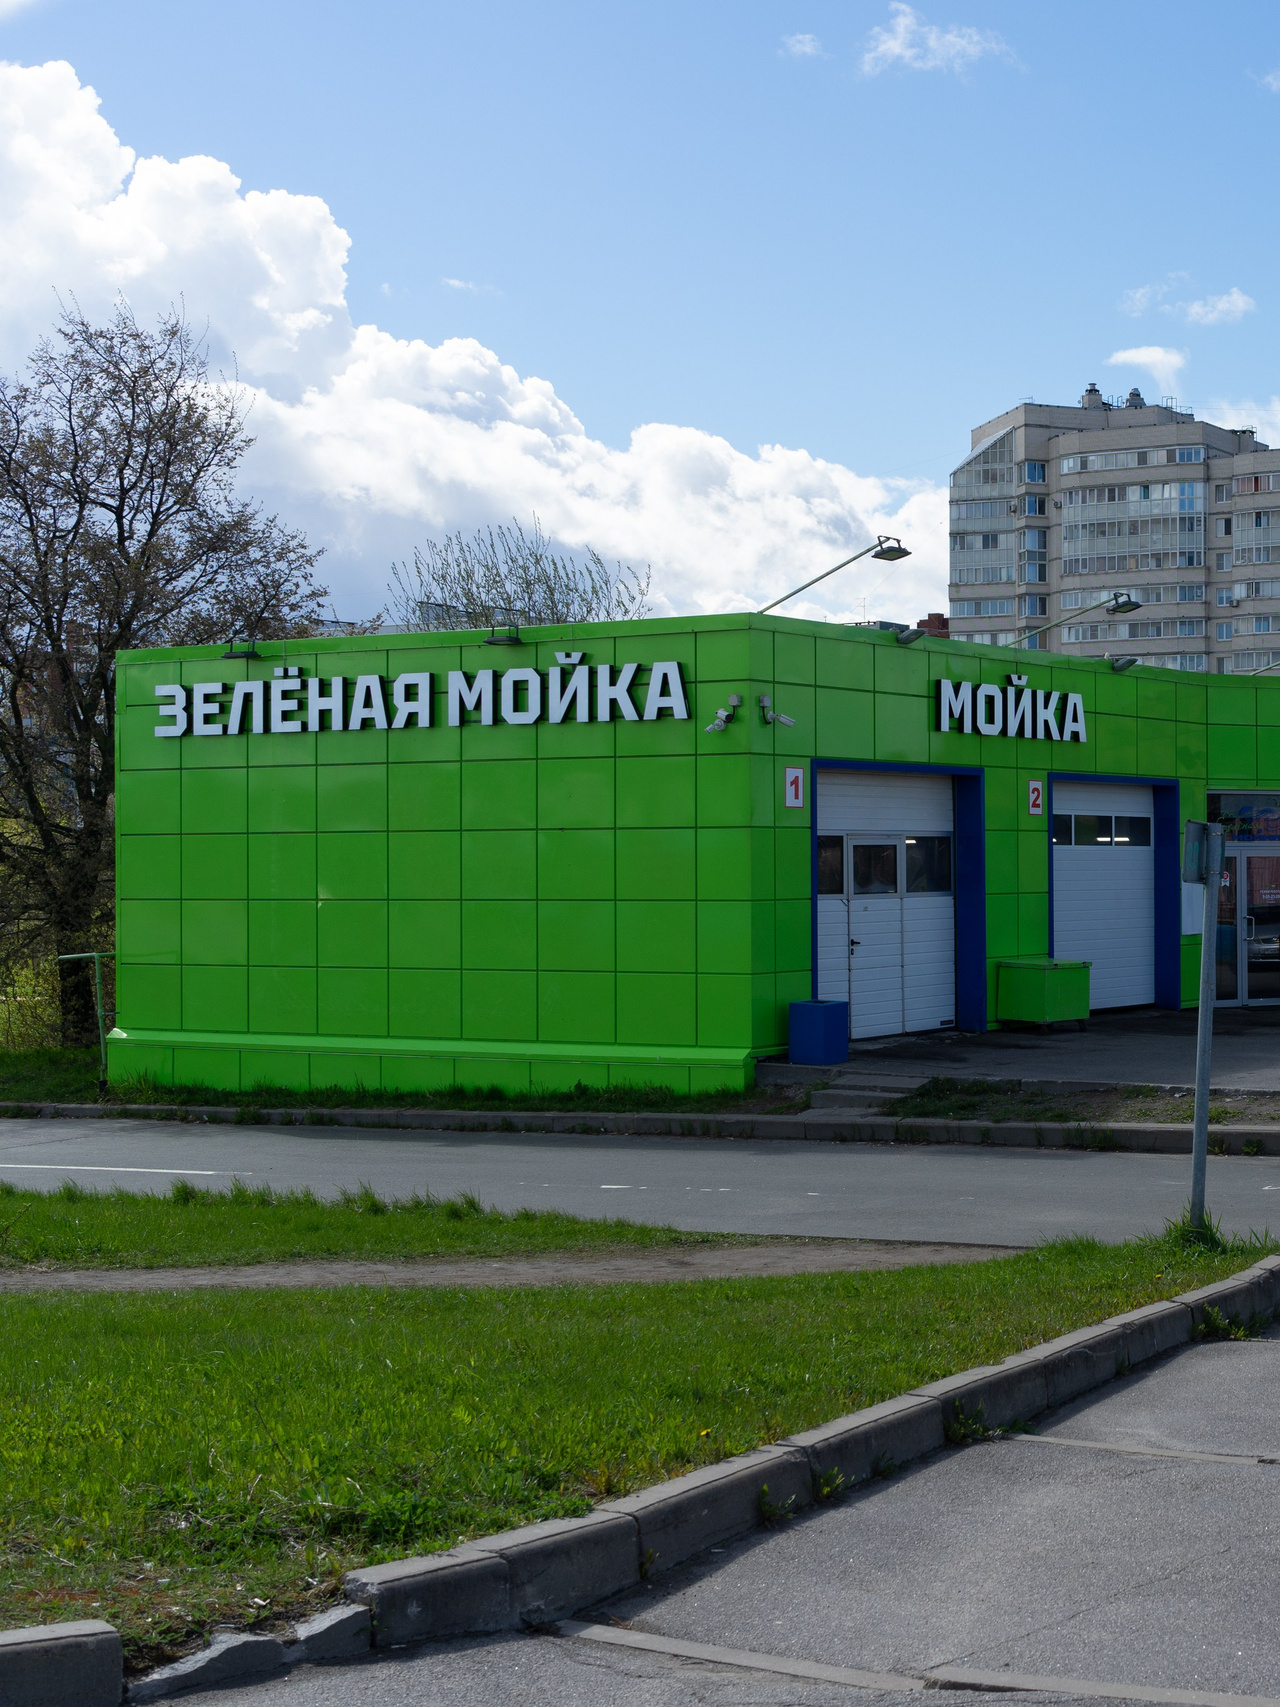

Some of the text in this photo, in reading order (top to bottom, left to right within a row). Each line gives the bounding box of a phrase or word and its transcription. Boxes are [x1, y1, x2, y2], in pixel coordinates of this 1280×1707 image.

[154, 651, 689, 738] ЗЕЛЁНАЯ МОЙКА
[939, 674, 1088, 743] МОЙКА
[789, 776, 801, 800] 1
[1031, 787, 1042, 808] 2
